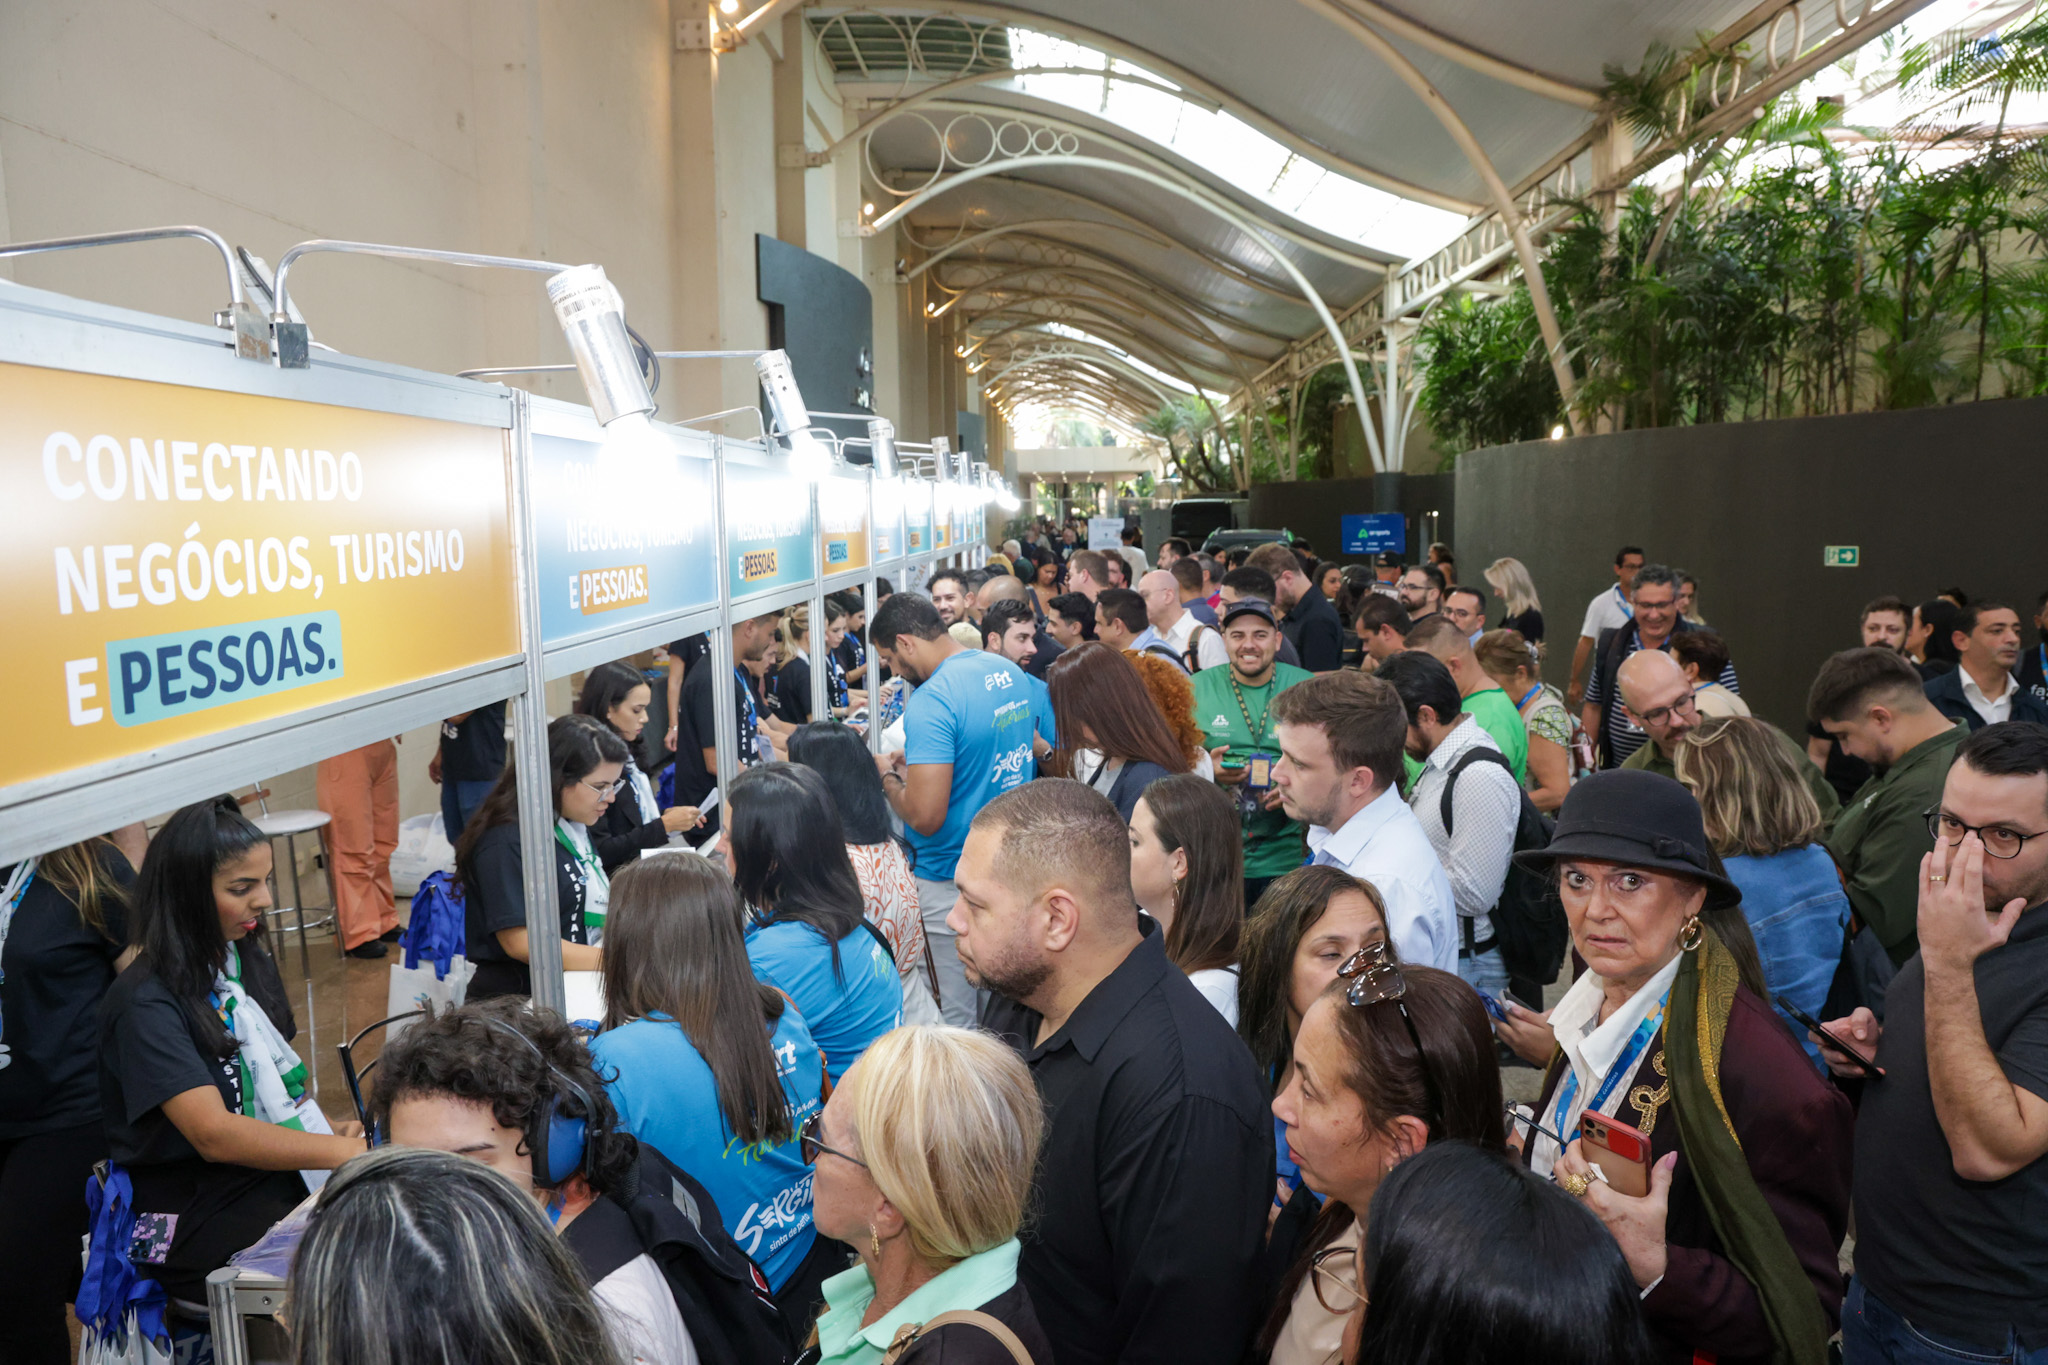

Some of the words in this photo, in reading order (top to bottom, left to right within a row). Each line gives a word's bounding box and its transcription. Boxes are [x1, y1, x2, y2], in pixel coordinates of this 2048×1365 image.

[42, 431, 364, 502] CONECTANDO
[54, 521, 324, 615] NEGÓCIOS,
[330, 528, 464, 585] TURISMO
[569, 575, 579, 610] E
[582, 567, 648, 608] PESSOAS.
[744, 552, 777, 578] PESSOAS.
[64, 656, 104, 727] E
[119, 621, 337, 716] PESSOAS.
[769, 1233, 788, 1252] sinta
[788, 1225, 798, 1239] de
[796, 1213, 811, 1233] perto
